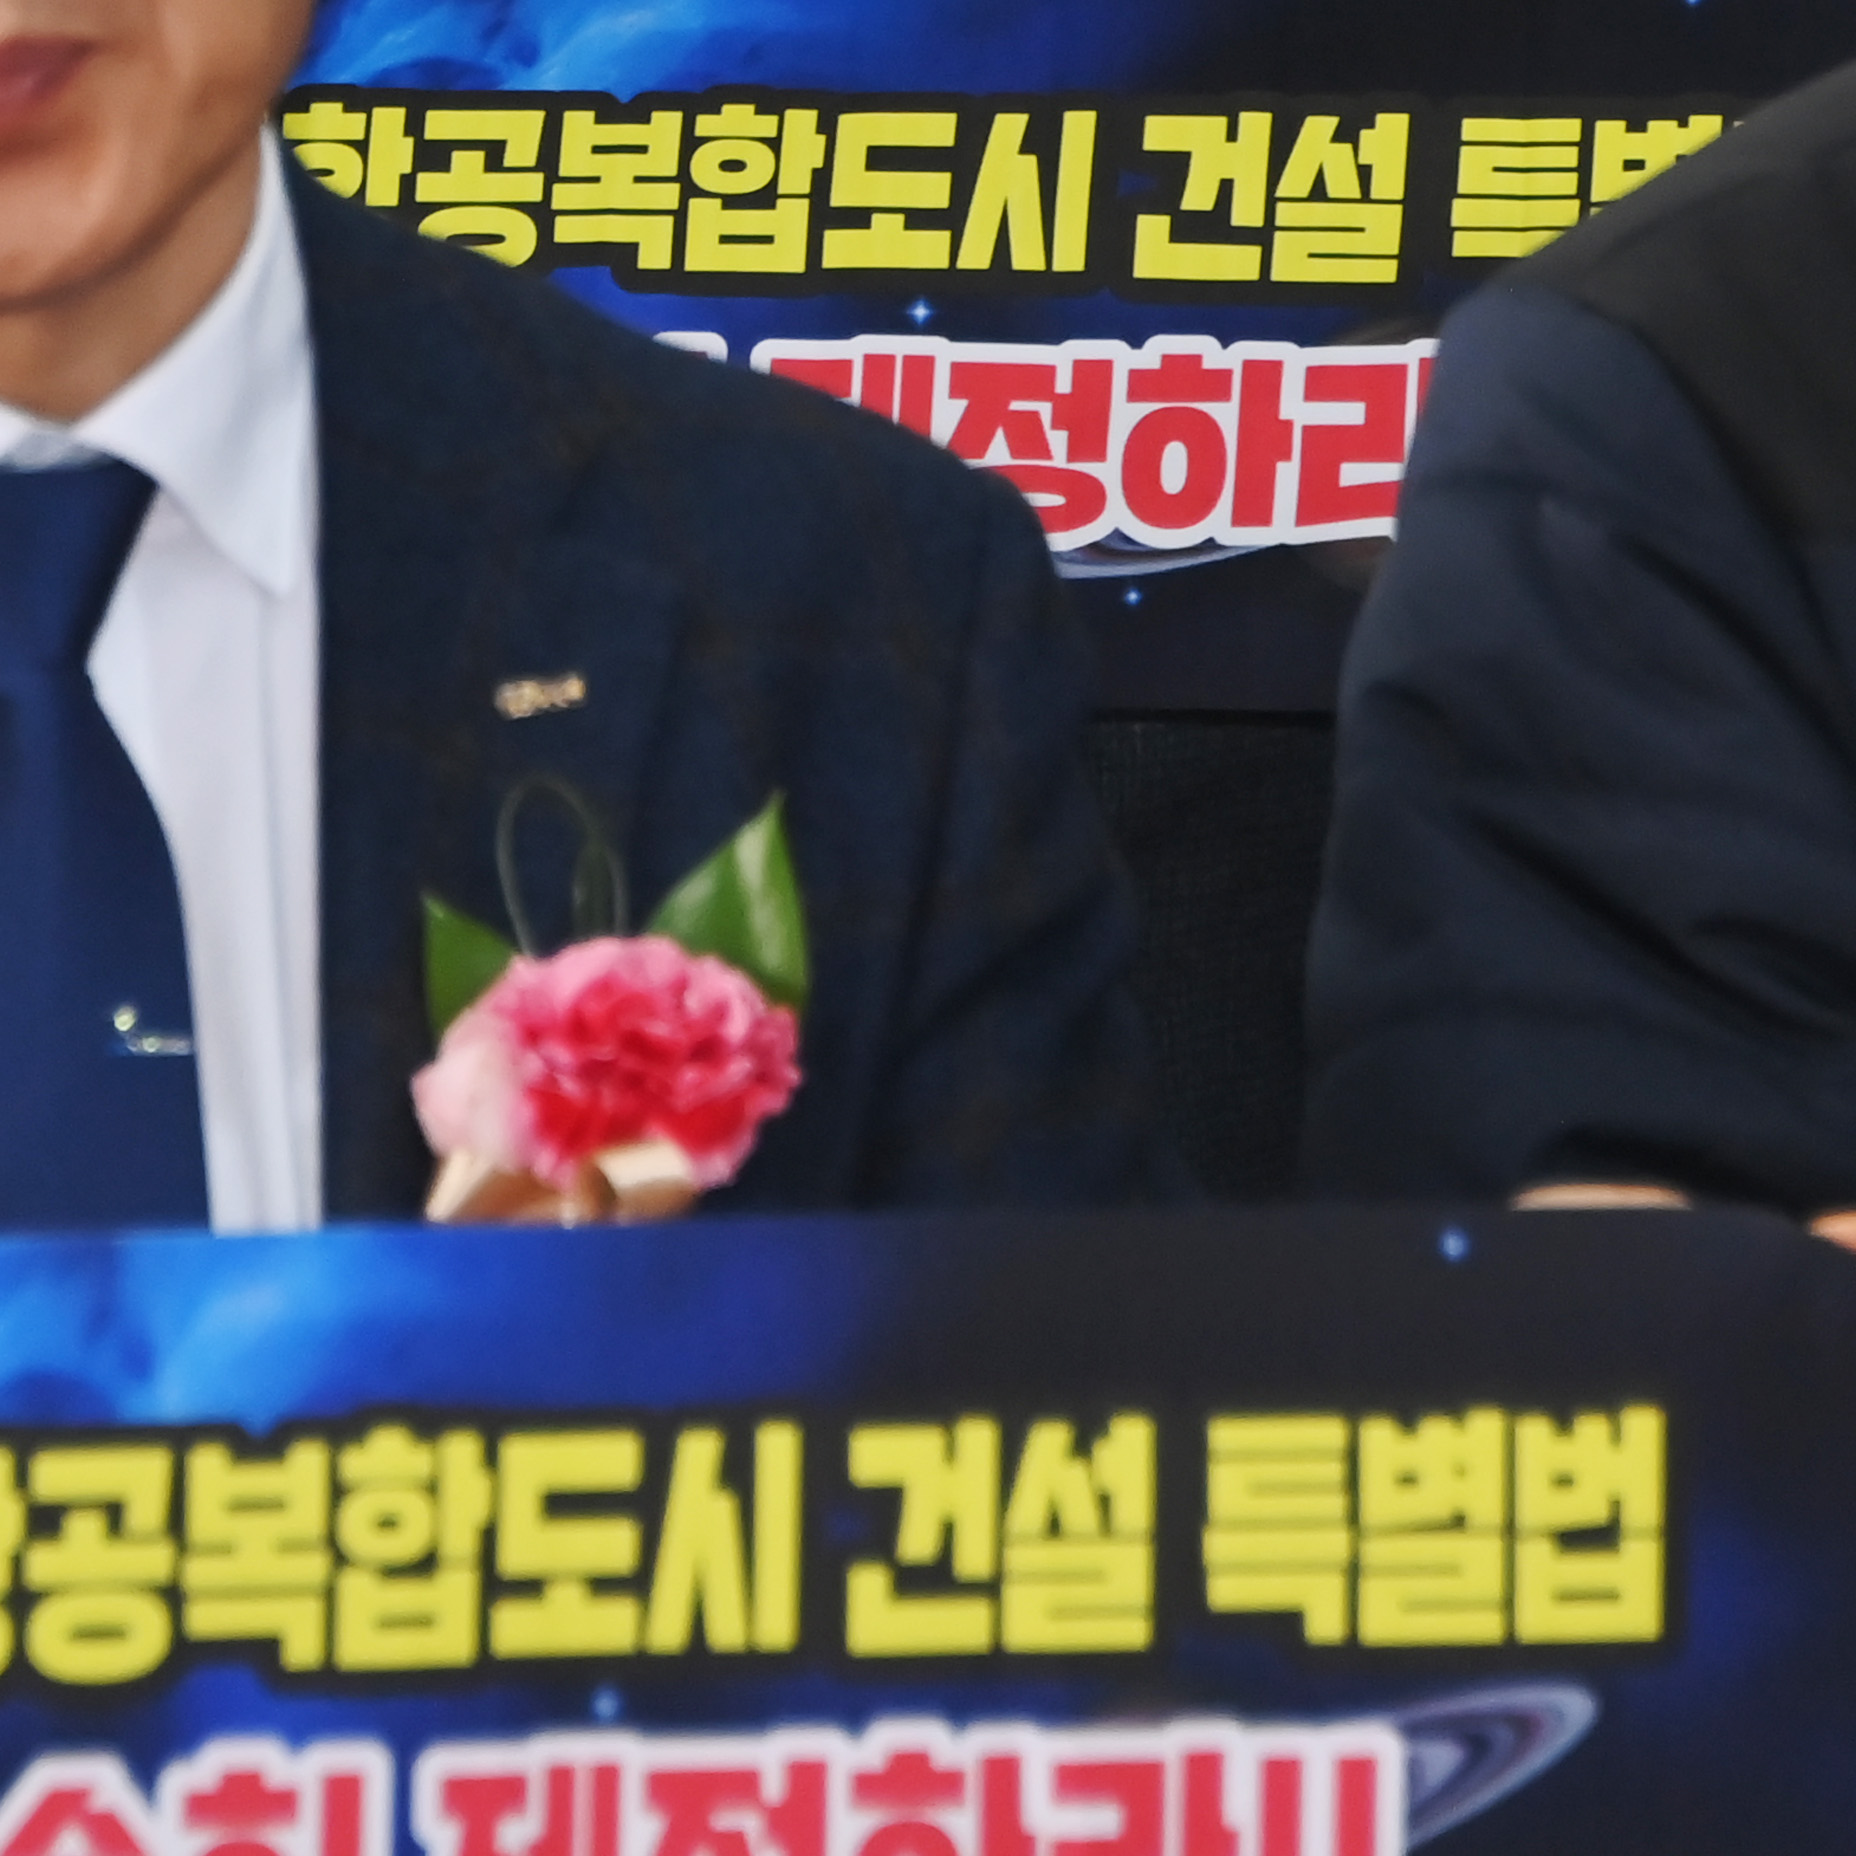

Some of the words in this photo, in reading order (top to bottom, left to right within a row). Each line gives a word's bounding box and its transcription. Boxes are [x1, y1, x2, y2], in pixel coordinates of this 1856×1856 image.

[1135, 111, 1411, 284] 건설
[846, 1412, 1157, 1657] 건설
[1202, 1404, 1667, 1648] 특별법
